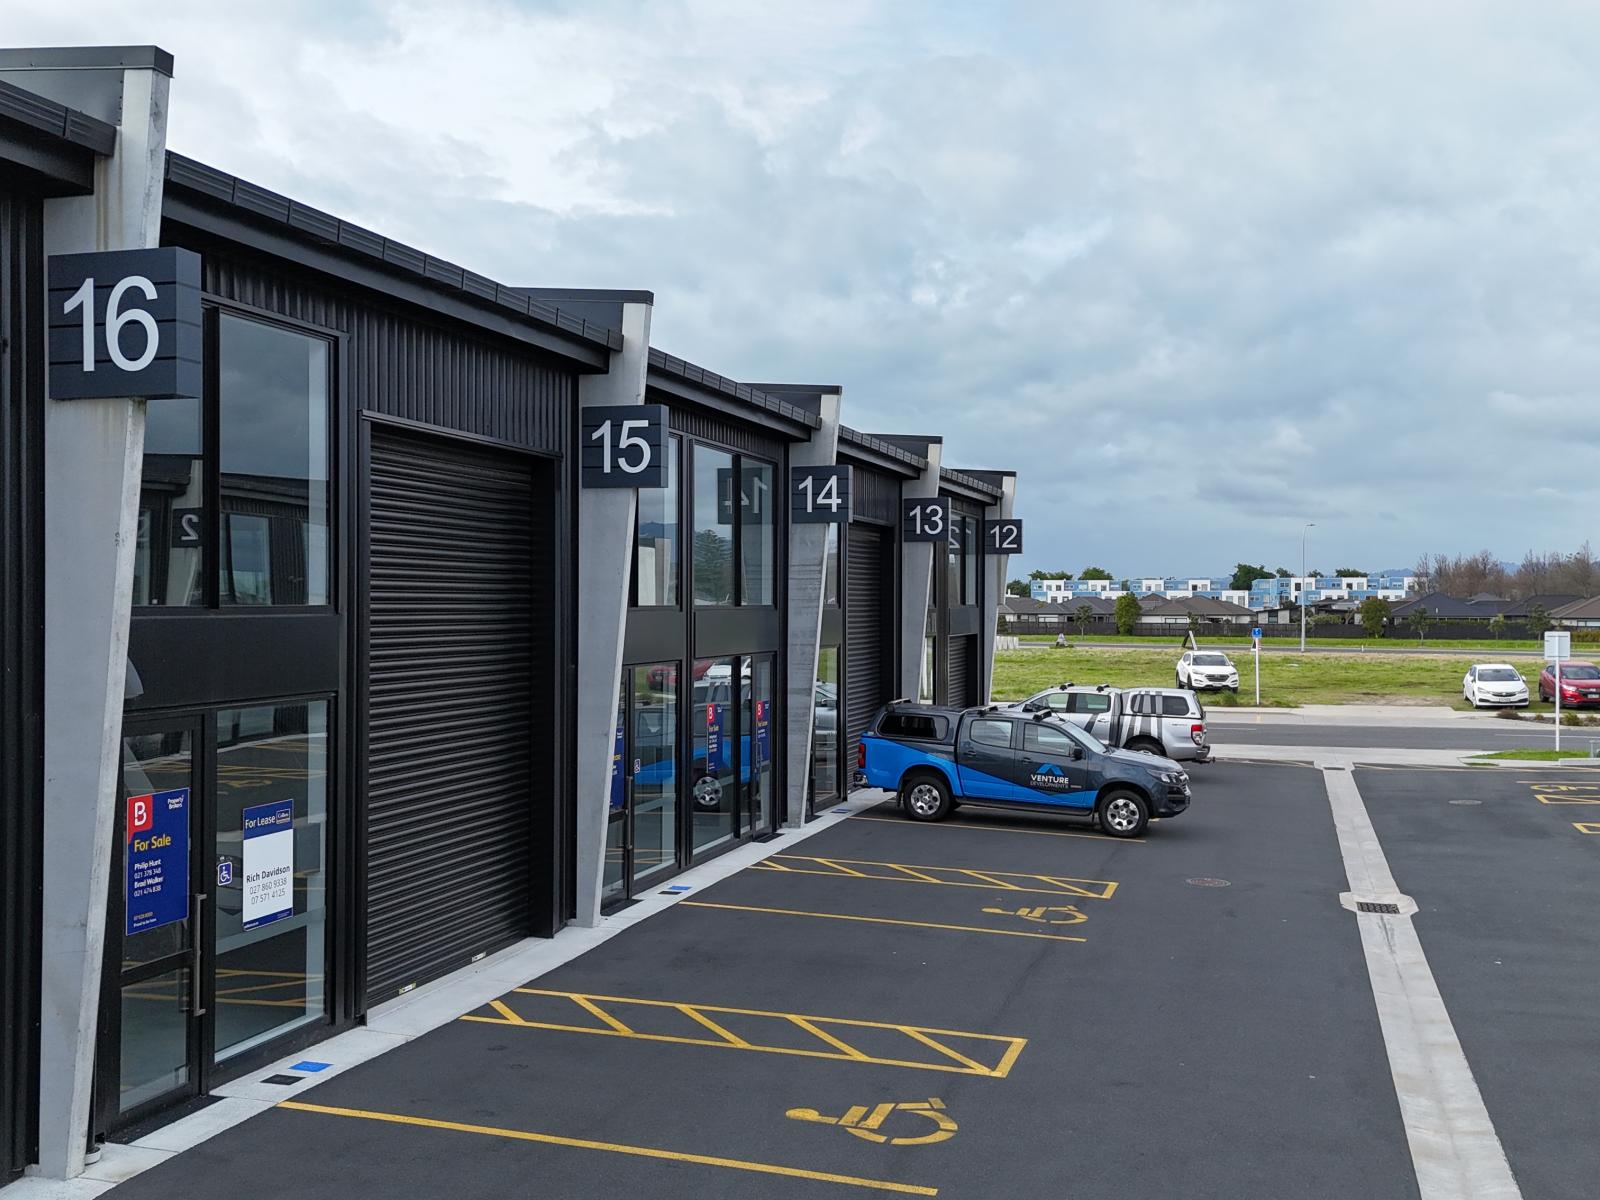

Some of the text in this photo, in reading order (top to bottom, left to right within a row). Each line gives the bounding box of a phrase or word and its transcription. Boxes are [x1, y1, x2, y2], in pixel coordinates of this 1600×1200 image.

[63, 275, 160, 372] 16
[591, 419, 651, 474] 15
[798, 475, 842, 513] 14
[909, 504, 943, 535] 13
[990, 524, 1018, 548] 12
[1030, 774, 1069, 784] VENTURE
[134, 801, 147, 826] B
[245, 819, 257, 830] For
[257, 815, 276, 827] Lease
[134, 834, 171, 853] For Sale
[246, 865, 291, 884] Rich Davidson
[251, 895, 259, 905] 07
